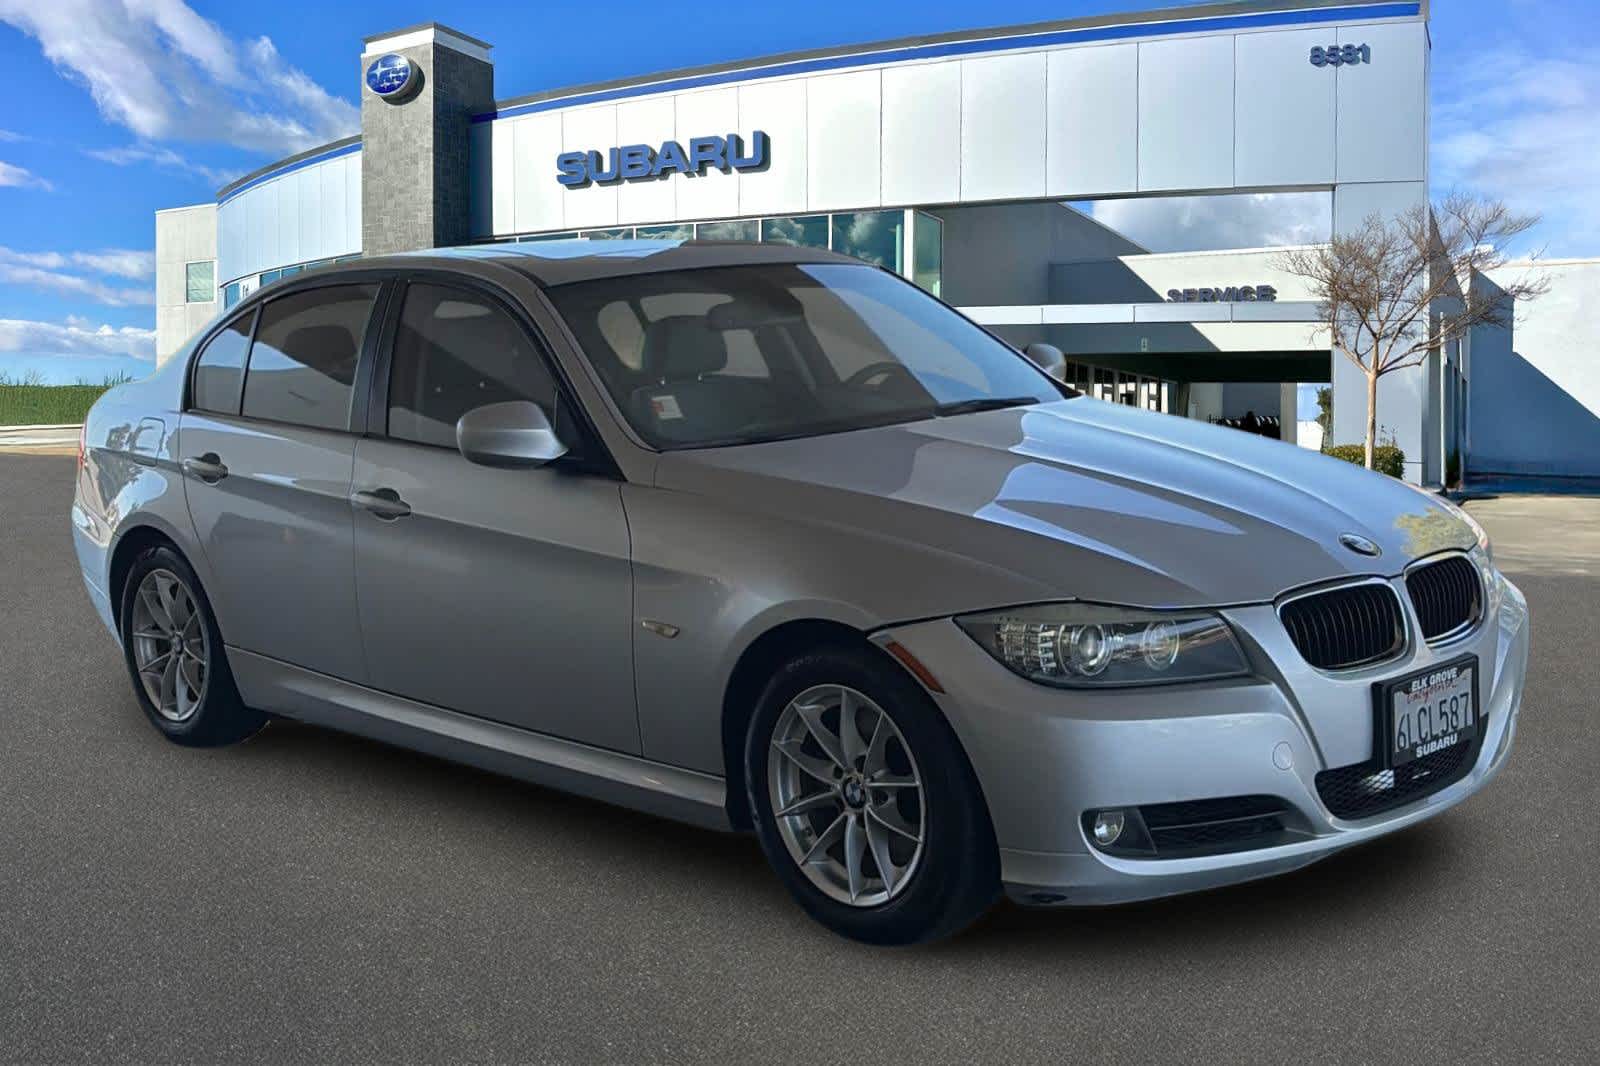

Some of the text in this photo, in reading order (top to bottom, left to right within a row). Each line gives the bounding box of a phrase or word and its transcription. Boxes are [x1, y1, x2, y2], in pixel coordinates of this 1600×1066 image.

[556, 130, 771, 190] SUBARU
[1166, 285, 1277, 302] SERVICE
[1411, 667, 1459, 692] ELK GROVE
[1416, 733, 1458, 758] SUBARU
